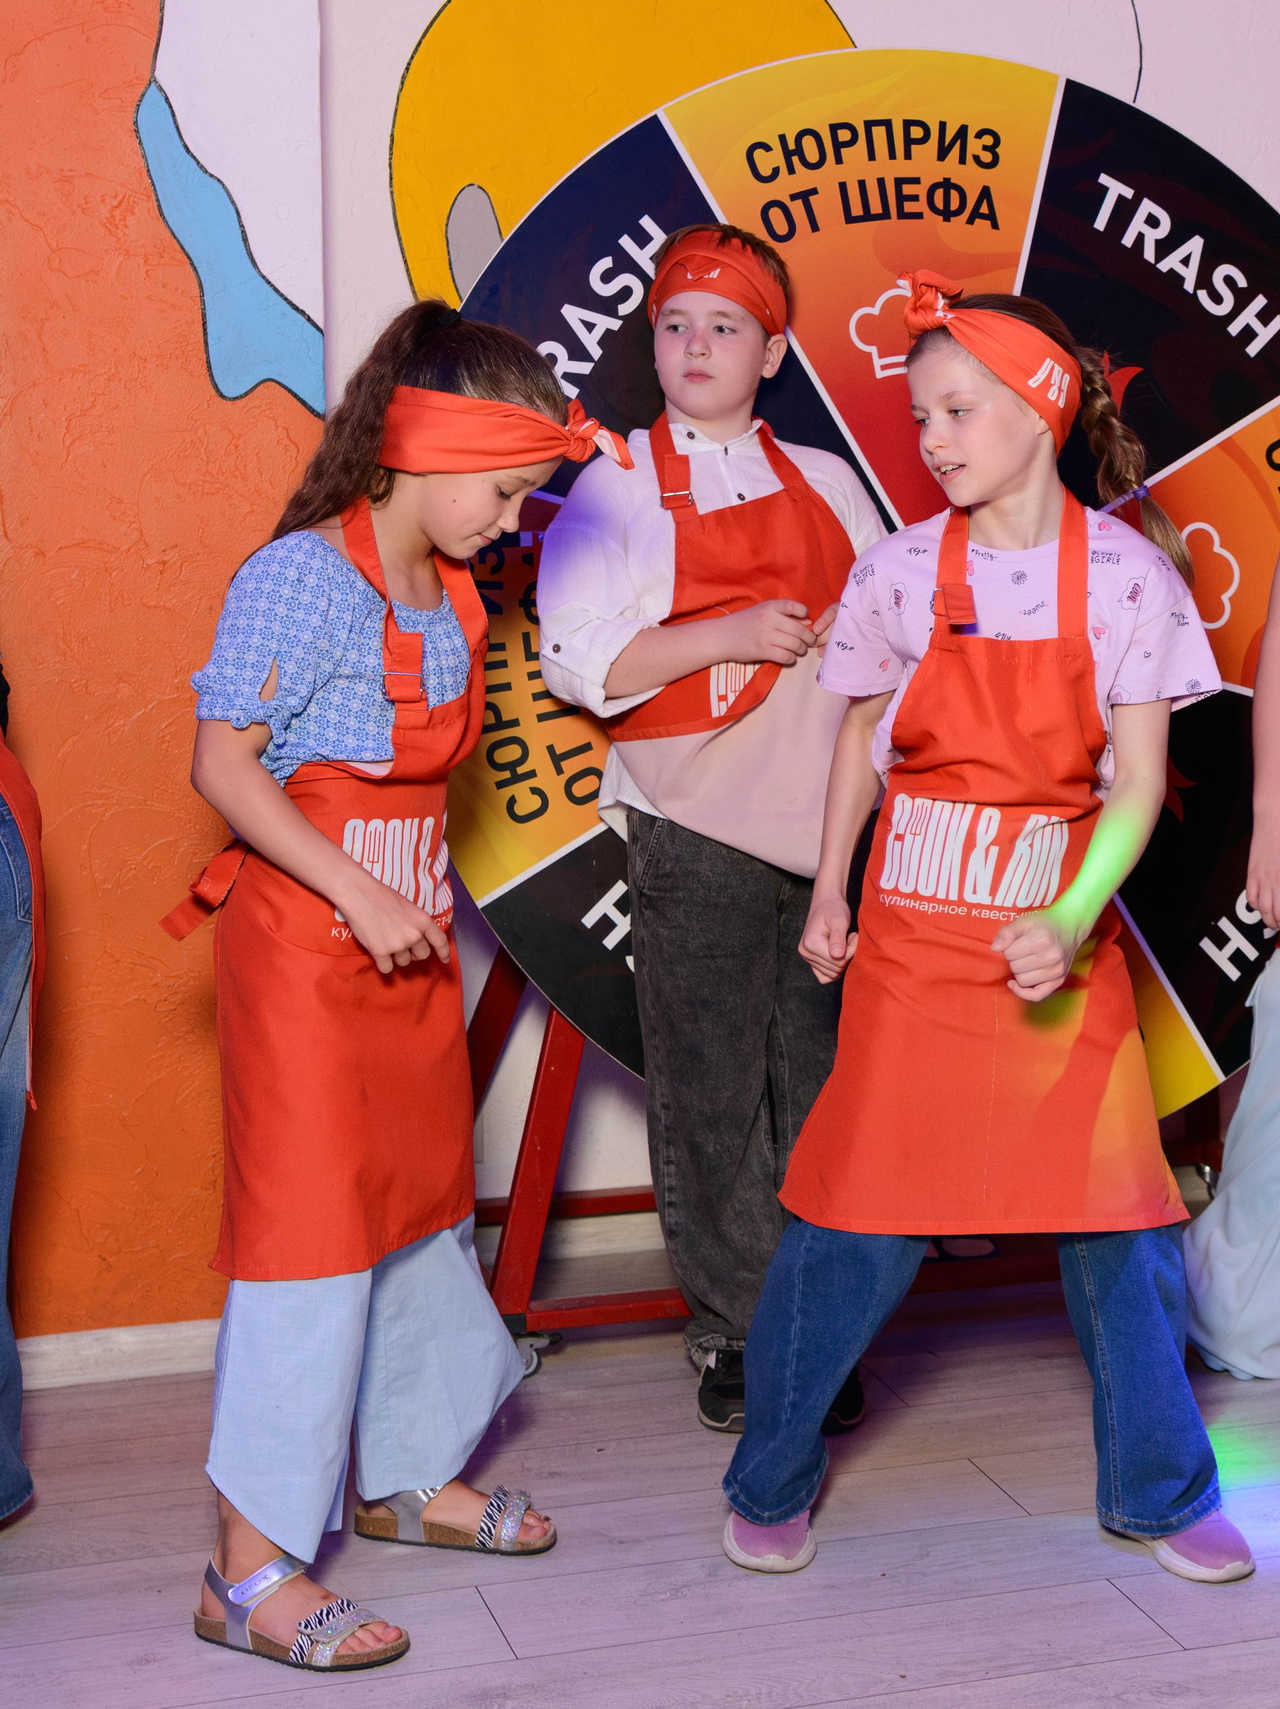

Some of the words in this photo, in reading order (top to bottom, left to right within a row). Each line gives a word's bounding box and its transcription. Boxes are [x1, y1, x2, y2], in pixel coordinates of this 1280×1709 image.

[745, 117, 1001, 184] СЮРПРИЗ
[760, 186, 822, 244] ОТ
[839, 176, 1000, 230] ШЕФА
[538, 214, 668, 399] RASH
[546, 741, 604, 806] ОТ
[879, 793, 976, 901] COOK
[994, 814, 1069, 908] RUN
[879, 892, 968, 916] кулинарное
[971, 907, 1047, 922] квест-
